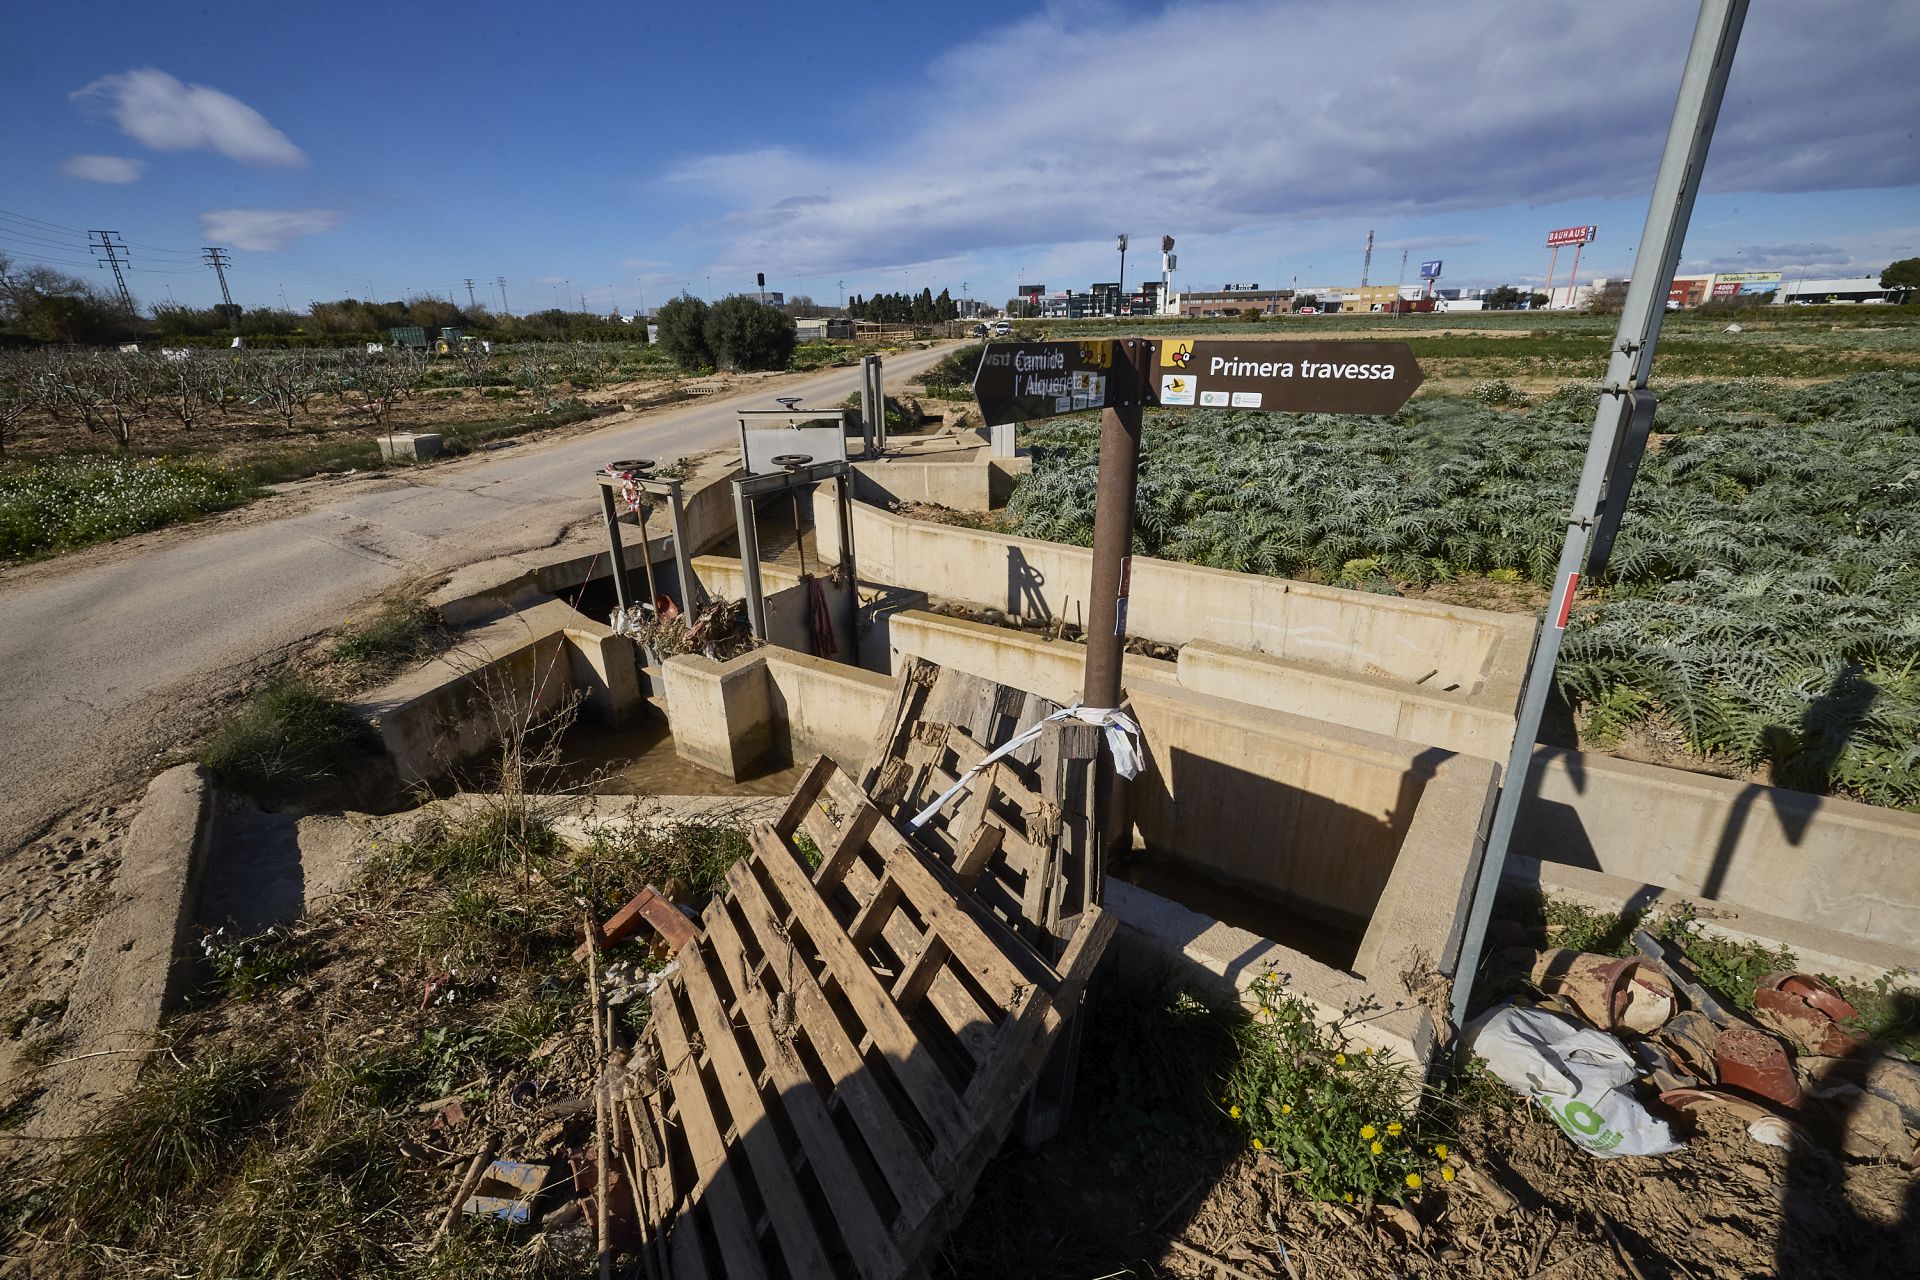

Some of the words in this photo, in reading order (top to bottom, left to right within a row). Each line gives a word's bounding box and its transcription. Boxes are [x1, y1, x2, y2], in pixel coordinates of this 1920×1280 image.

[1549, 228, 1585, 241] BAUHAUS
[1015, 347, 1047, 372] Camí
[1050, 347, 1064, 369] de
[1210, 356, 1294, 378] Primera
[1300, 359, 1395, 380] travessa
